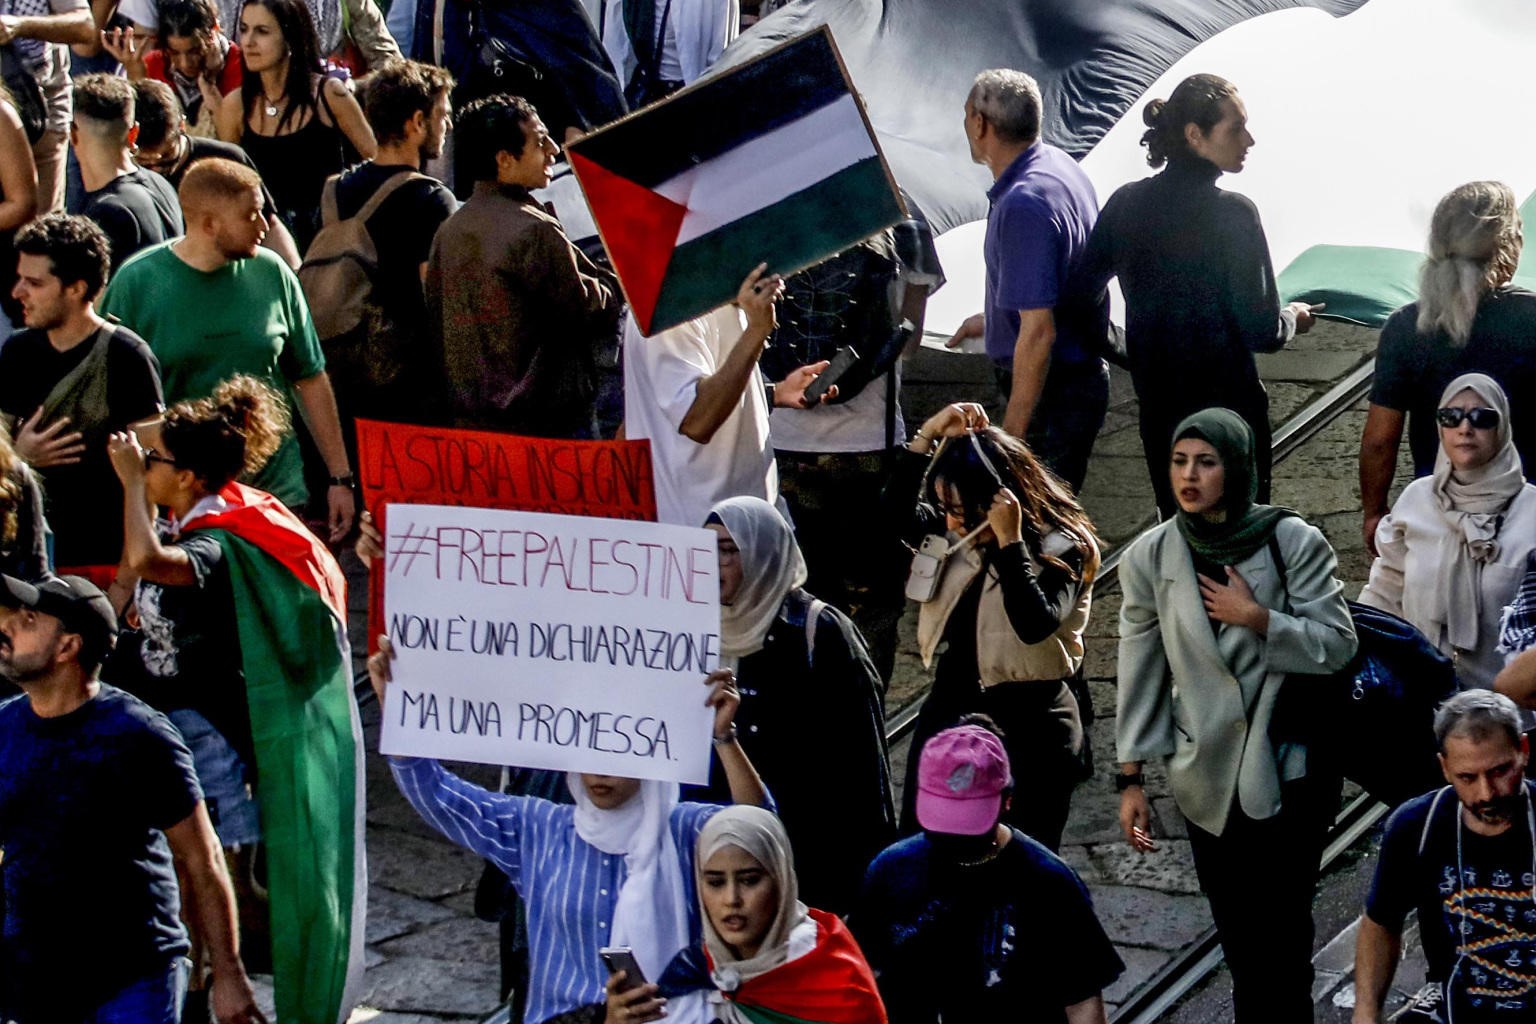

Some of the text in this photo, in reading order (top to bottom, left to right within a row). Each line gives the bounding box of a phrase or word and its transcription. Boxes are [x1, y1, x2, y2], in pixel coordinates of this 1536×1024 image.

[364, 430, 652, 507] LA STORIA INSEGNA
[388, 523, 714, 605] #FREEPALESTINE
[391, 613, 720, 677] NON È UNA DICHIARAZIONE
[400, 690, 679, 762] MA UNA PROMESSA.
